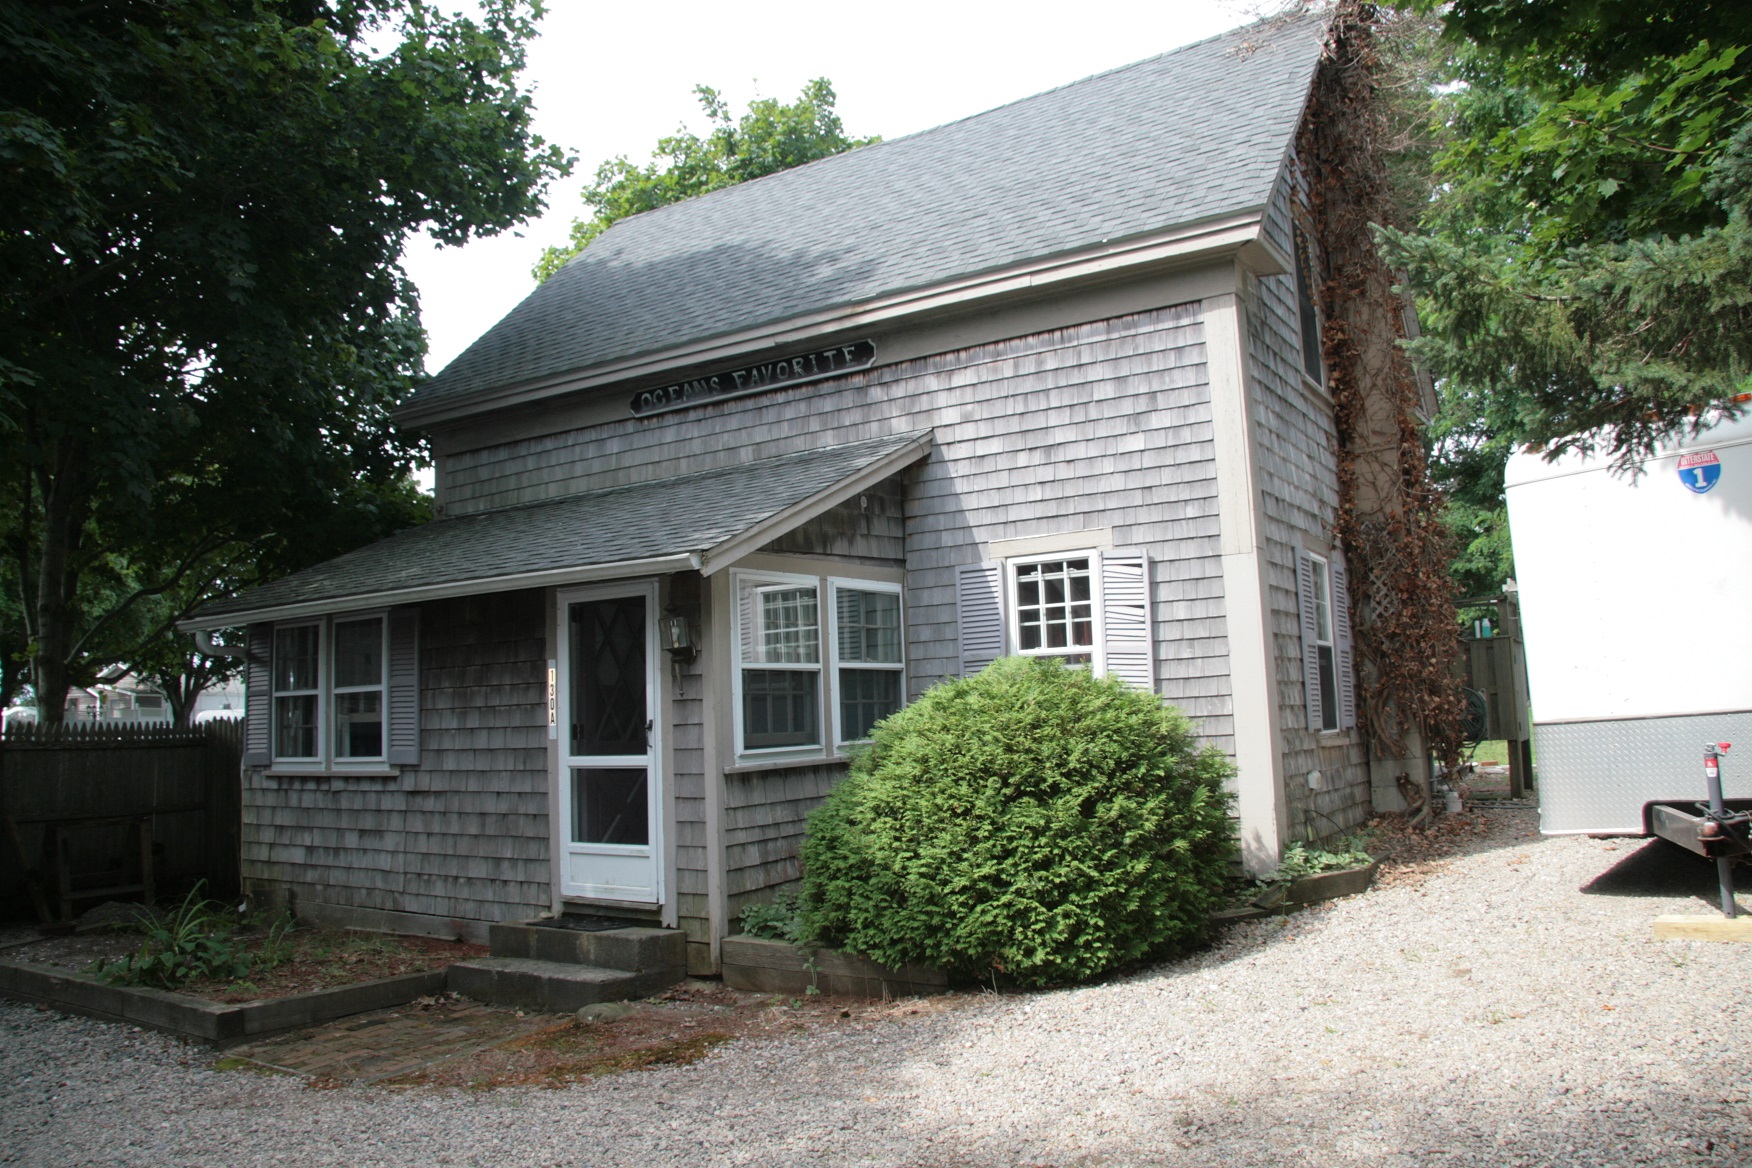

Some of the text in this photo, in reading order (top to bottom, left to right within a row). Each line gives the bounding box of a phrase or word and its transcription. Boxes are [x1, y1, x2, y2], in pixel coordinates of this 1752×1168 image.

[640, 346, 855, 409] OCEANS FAVORITE
[1680, 452, 1715, 466] INTERSTATE
[1692, 468, 1708, 488] 1
